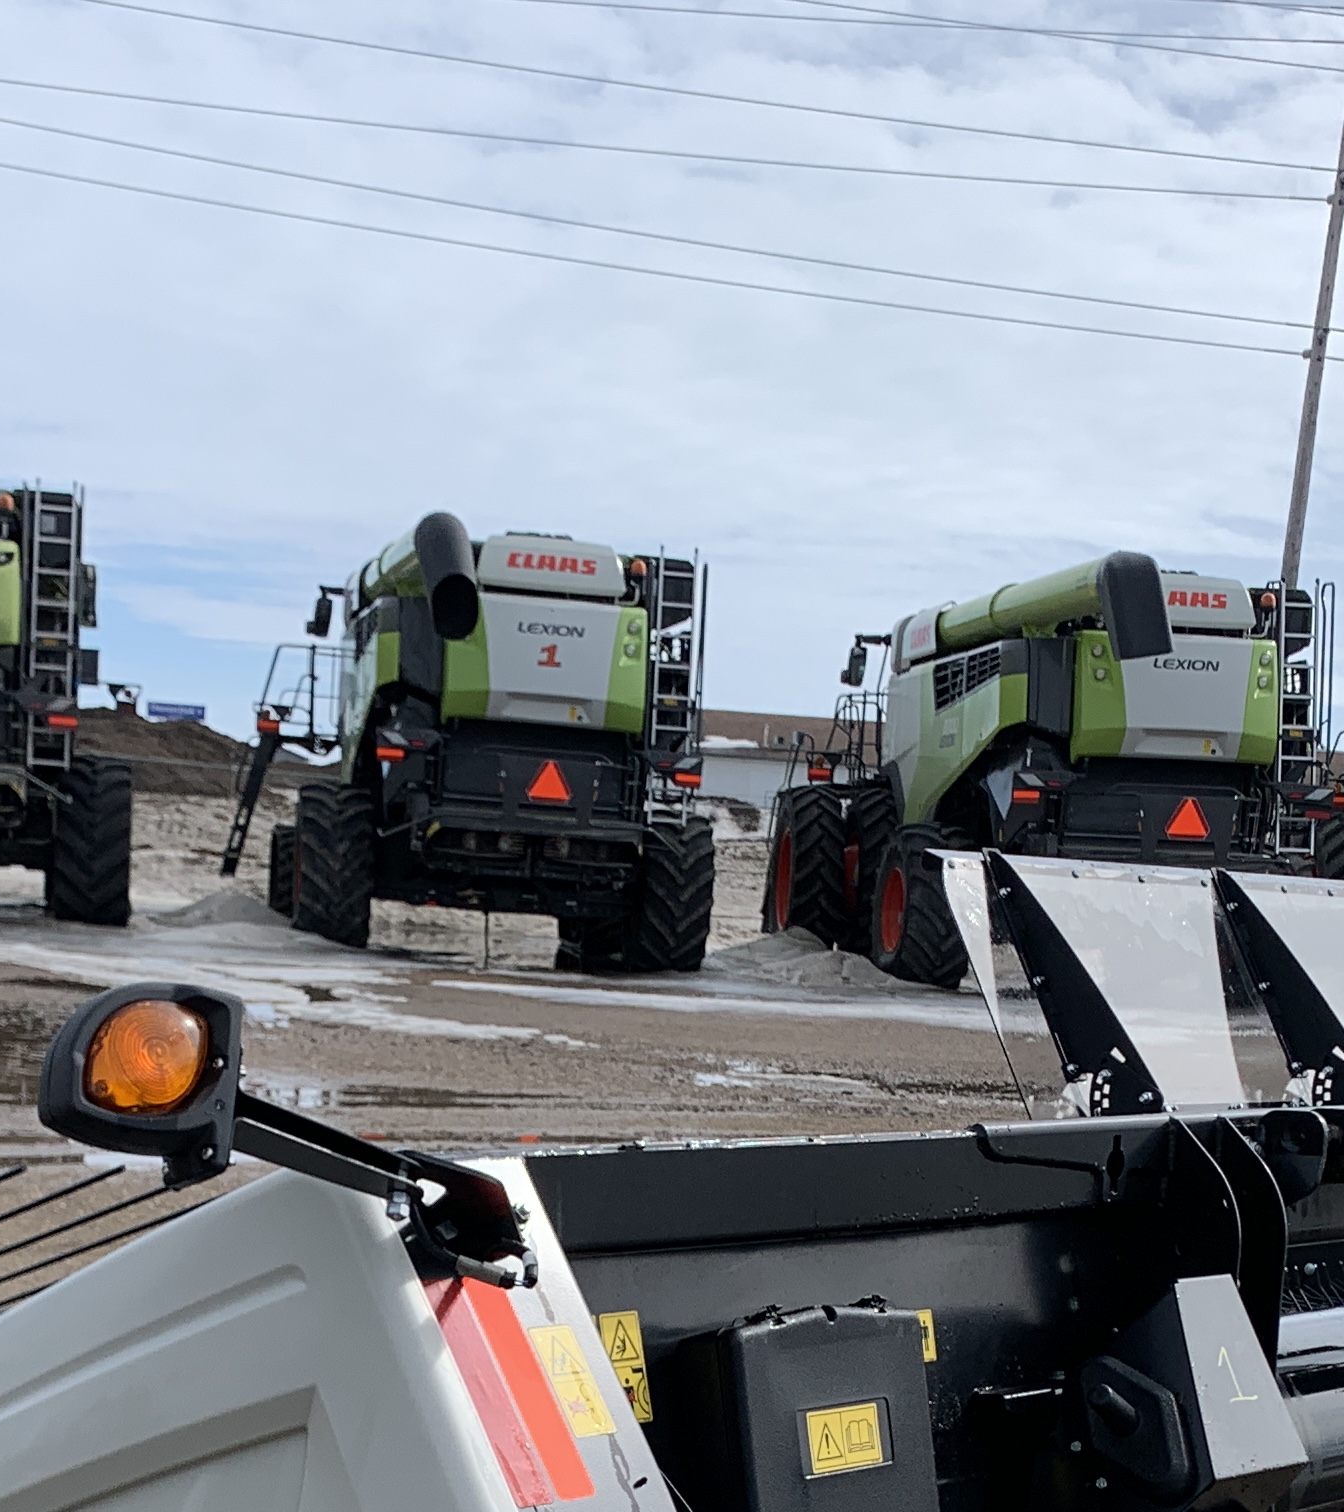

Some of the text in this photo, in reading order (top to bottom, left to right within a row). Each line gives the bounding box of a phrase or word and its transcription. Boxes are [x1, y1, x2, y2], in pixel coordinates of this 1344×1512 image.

[506, 551, 598, 576] CLAAS
[1167, 590, 1228, 609] AAS
[517, 620, 586, 638] LEXION
[537, 643, 562, 668] 1
[1153, 657, 1220, 672] LEXION
[1217, 1345, 1259, 1404] 1
